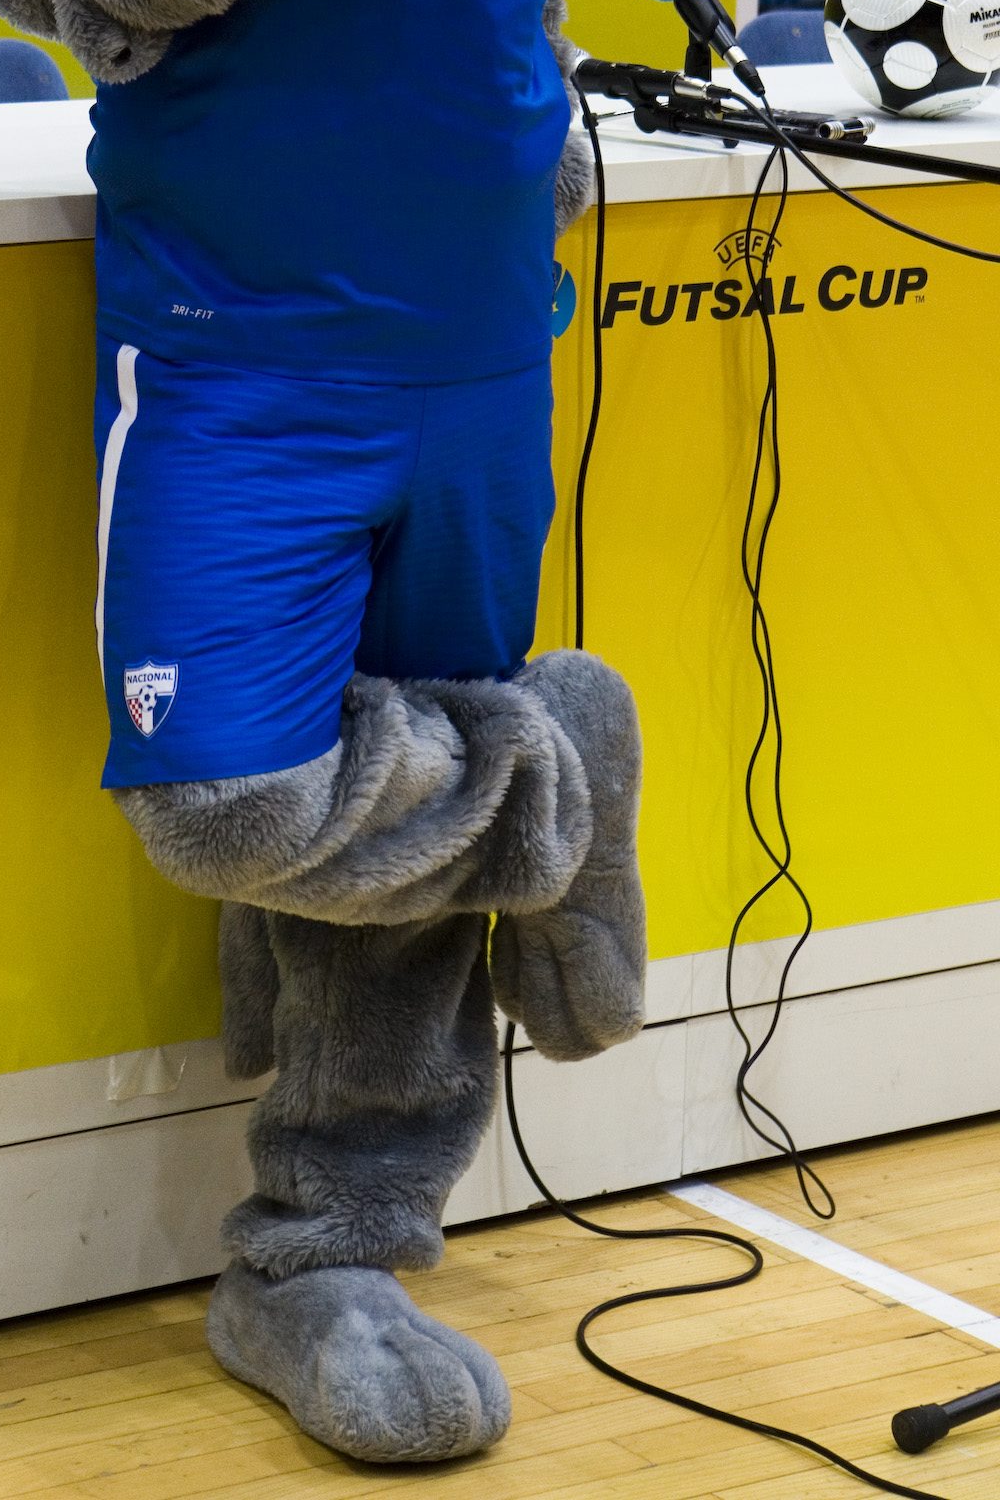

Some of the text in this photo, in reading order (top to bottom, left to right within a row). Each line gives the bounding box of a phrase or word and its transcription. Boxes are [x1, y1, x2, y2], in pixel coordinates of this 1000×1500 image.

[601, 275, 805, 329] FUTSAL
[817, 264, 929, 312] CUP
[171, 304, 215, 319] DRI-FIT
[127, 671, 173, 684] NACIONAL
